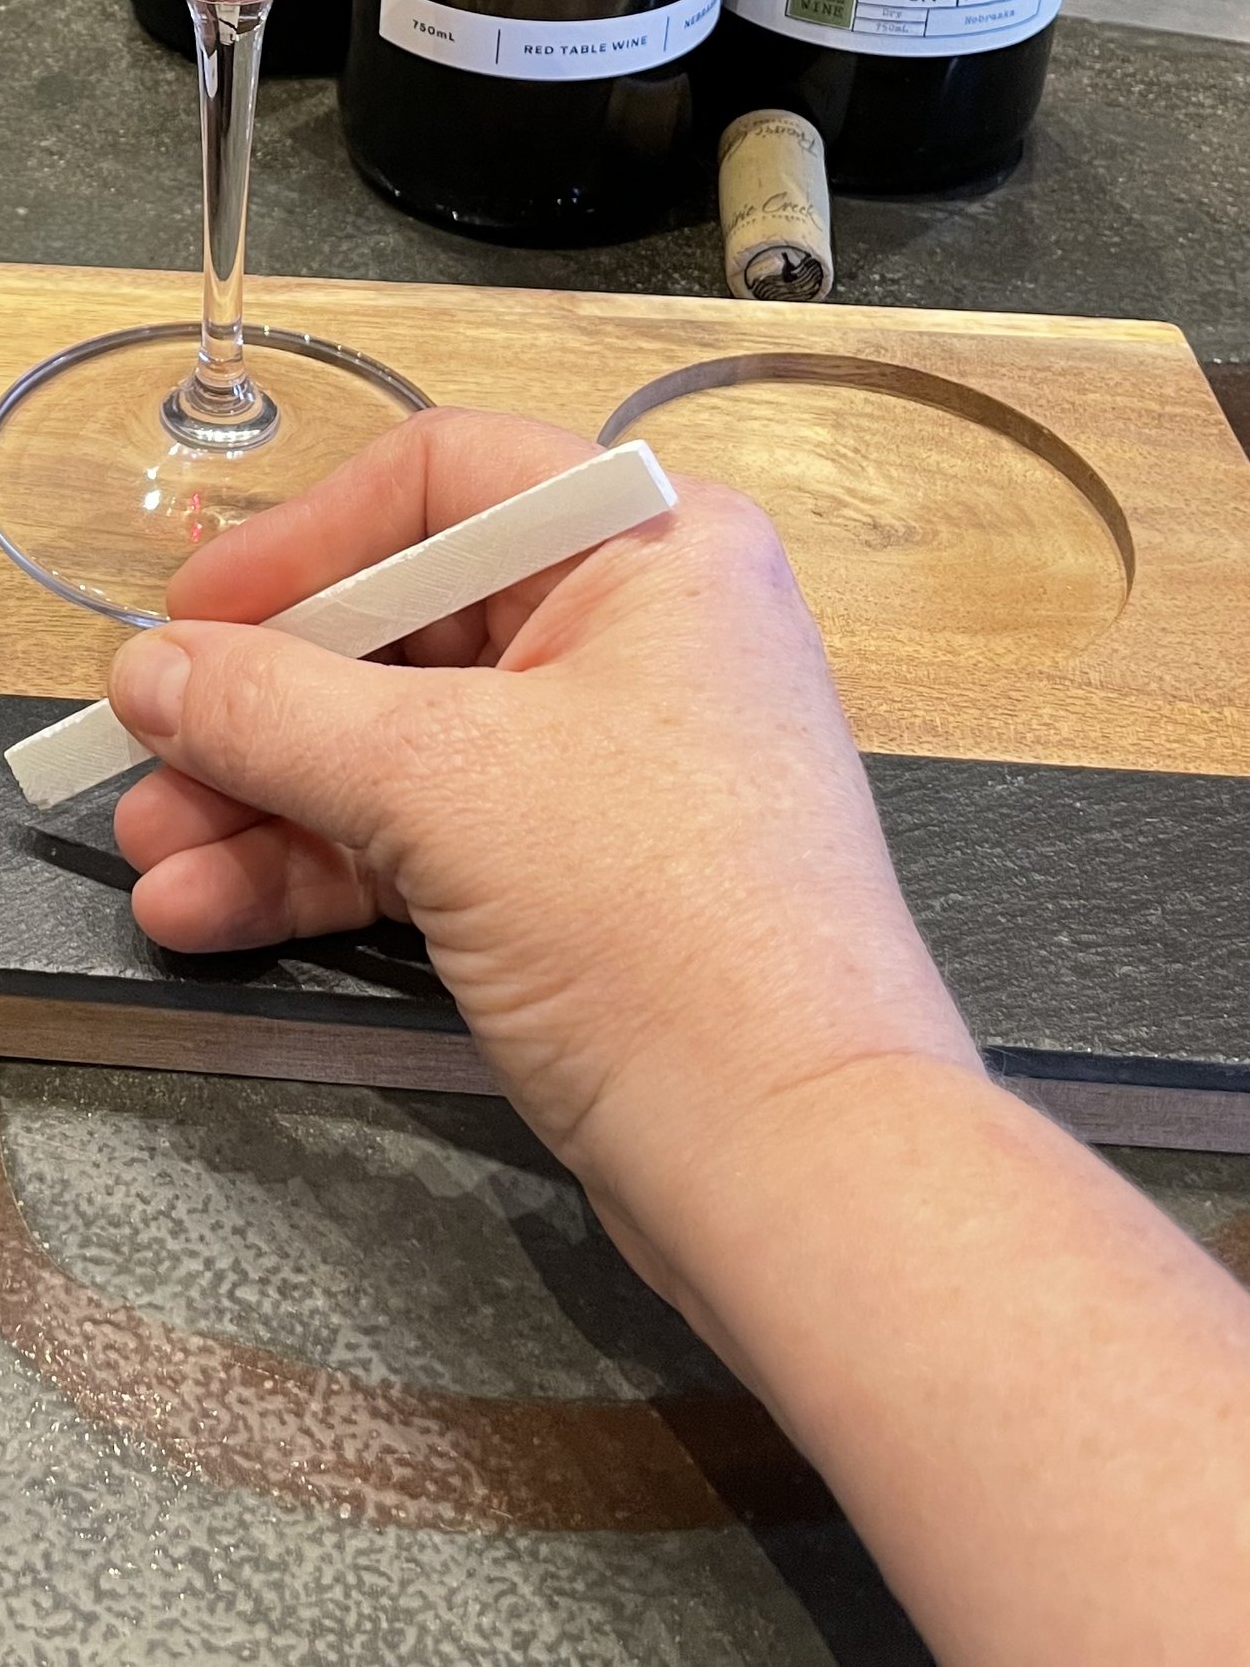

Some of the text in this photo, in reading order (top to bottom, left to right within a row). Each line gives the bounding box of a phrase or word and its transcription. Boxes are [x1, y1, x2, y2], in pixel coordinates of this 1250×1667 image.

[800, 1, 845, 18] WINE
[412, 19, 455, 43] 750mL
[524, 35, 648, 56] RED TABLE WINE
